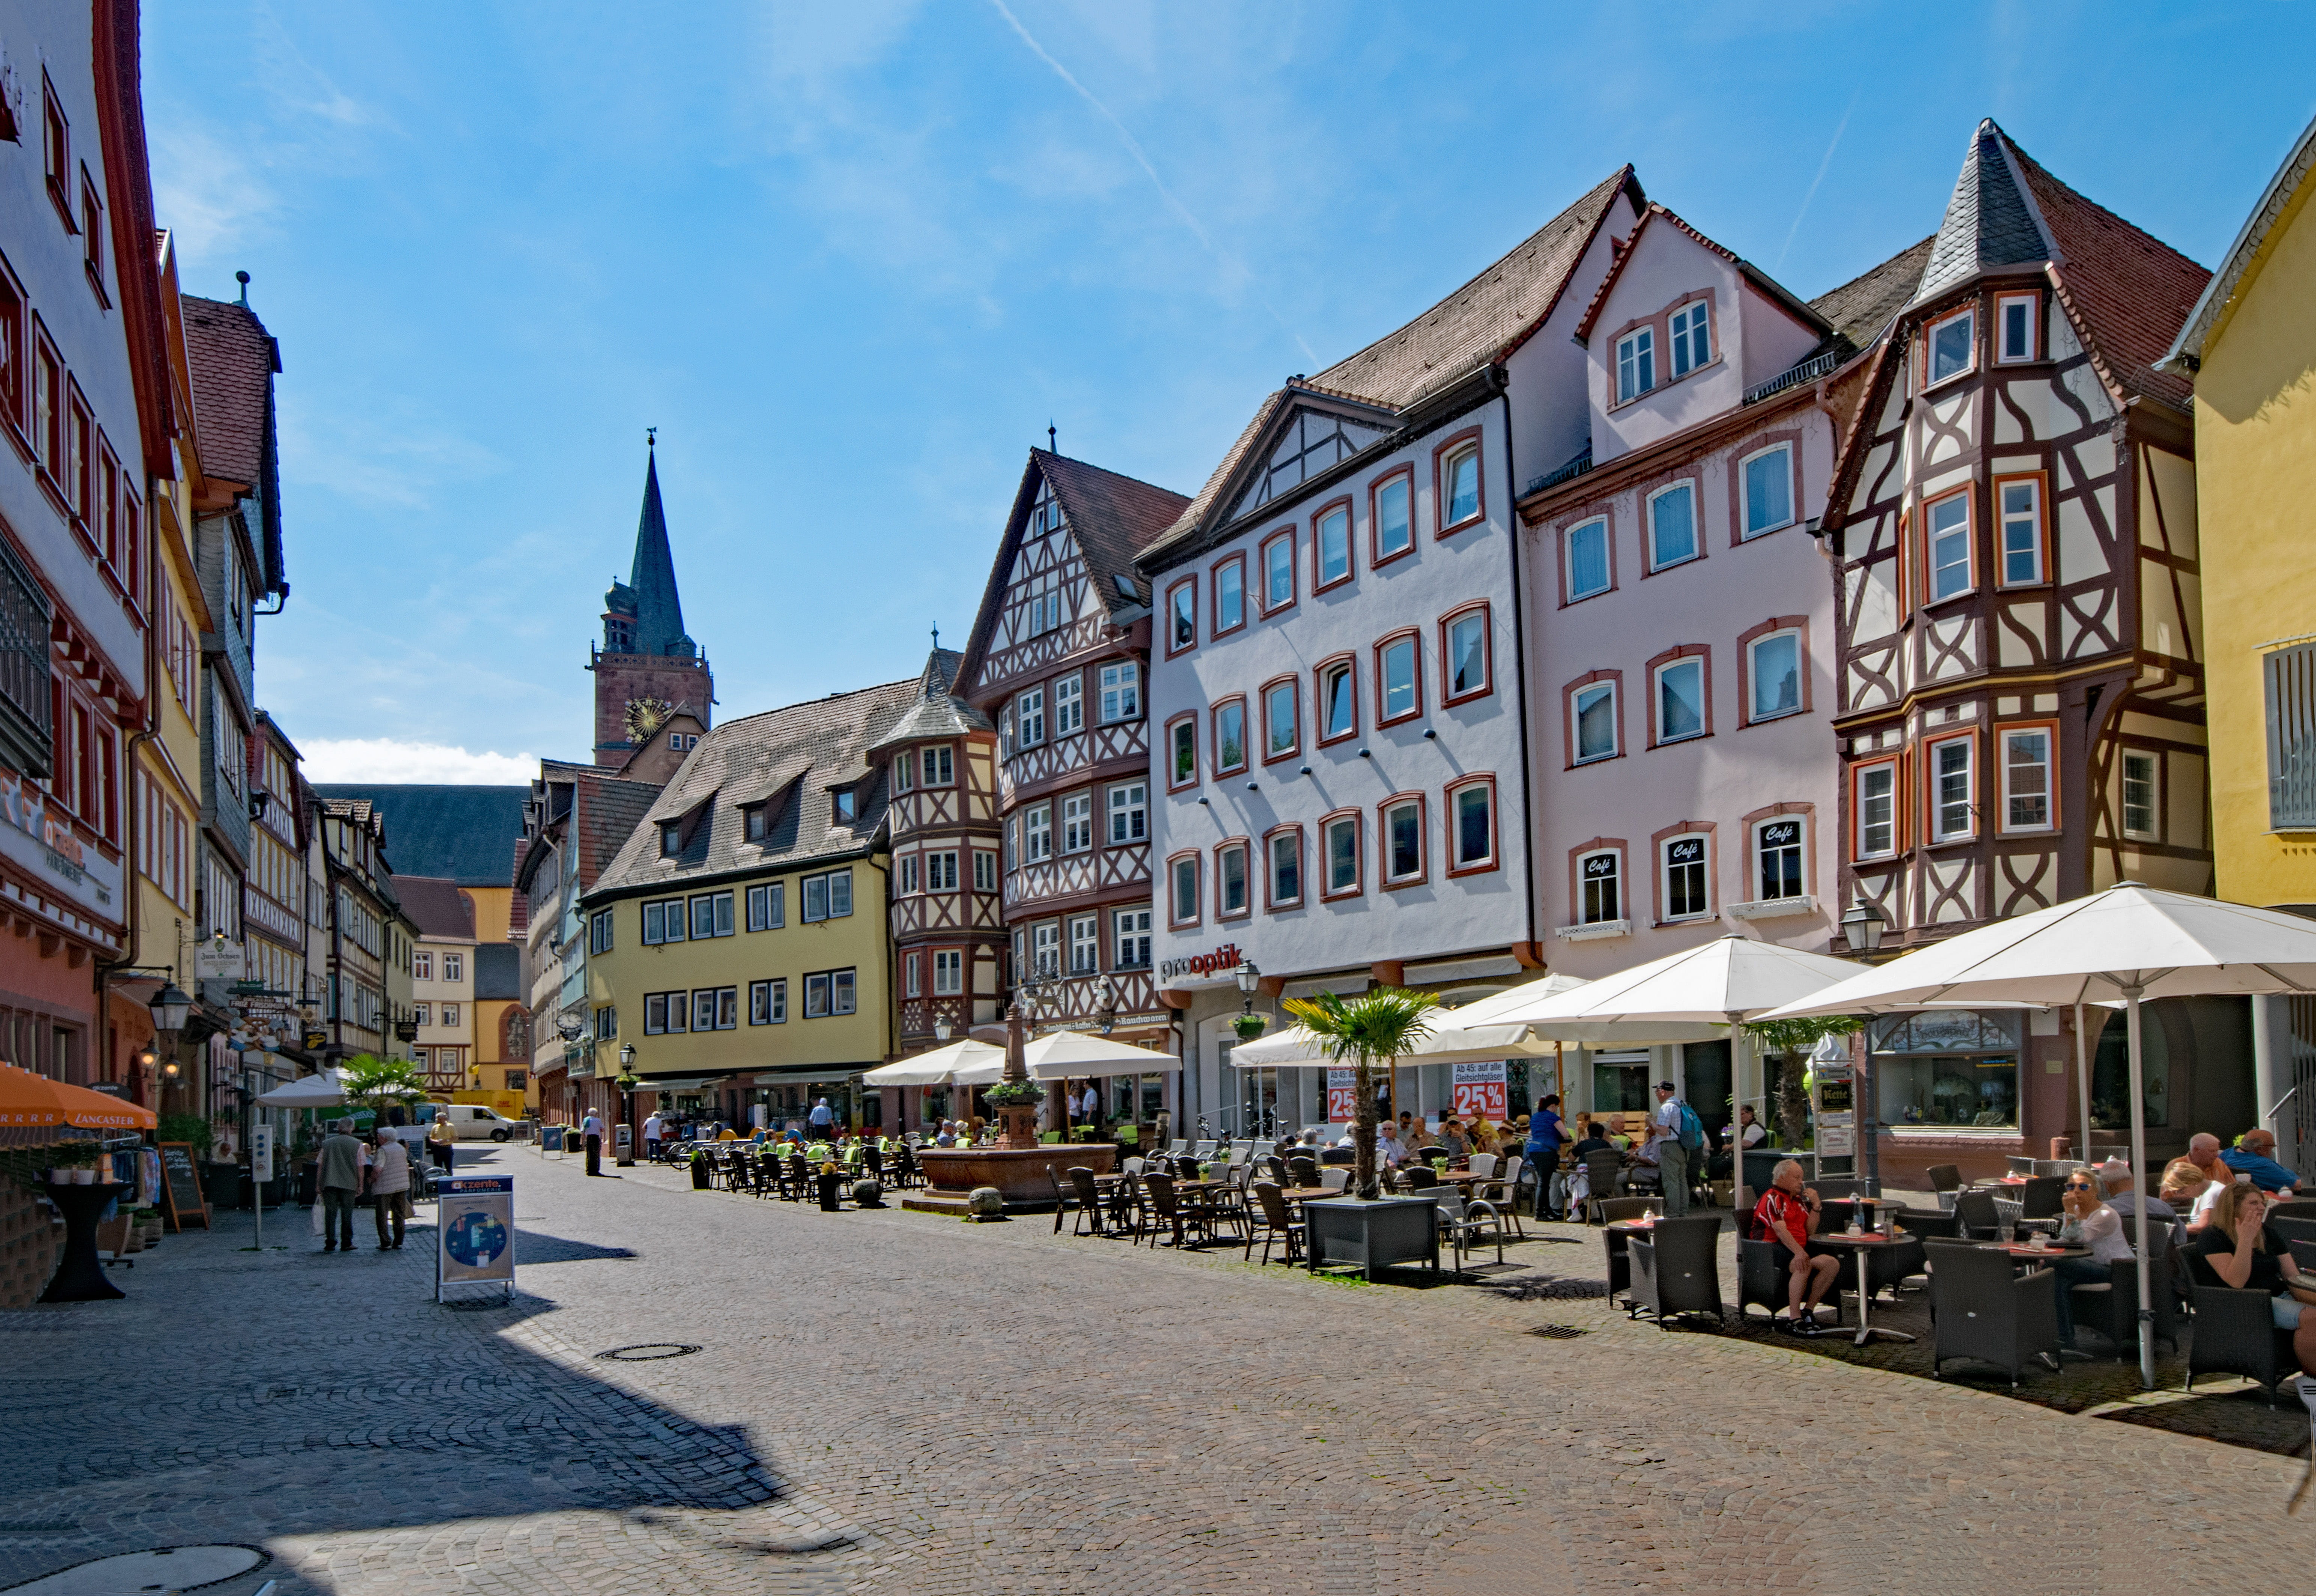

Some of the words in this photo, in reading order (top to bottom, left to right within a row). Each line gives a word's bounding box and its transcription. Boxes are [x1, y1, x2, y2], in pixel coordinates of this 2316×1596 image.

[1766, 826, 1793, 842] Café
[1673, 843, 1698, 859] Café
[1588, 859, 1610, 873] Café
[1121, 1015, 1167, 1025] Rauchwaren
[1467, 1064, 1476, 1072] 45:
[1490, 1062, 1502, 1071] alle
[1455, 1073, 1503, 1083] Gleitsichtgläser
[75, 1113, 134, 1125] LANCASTER
